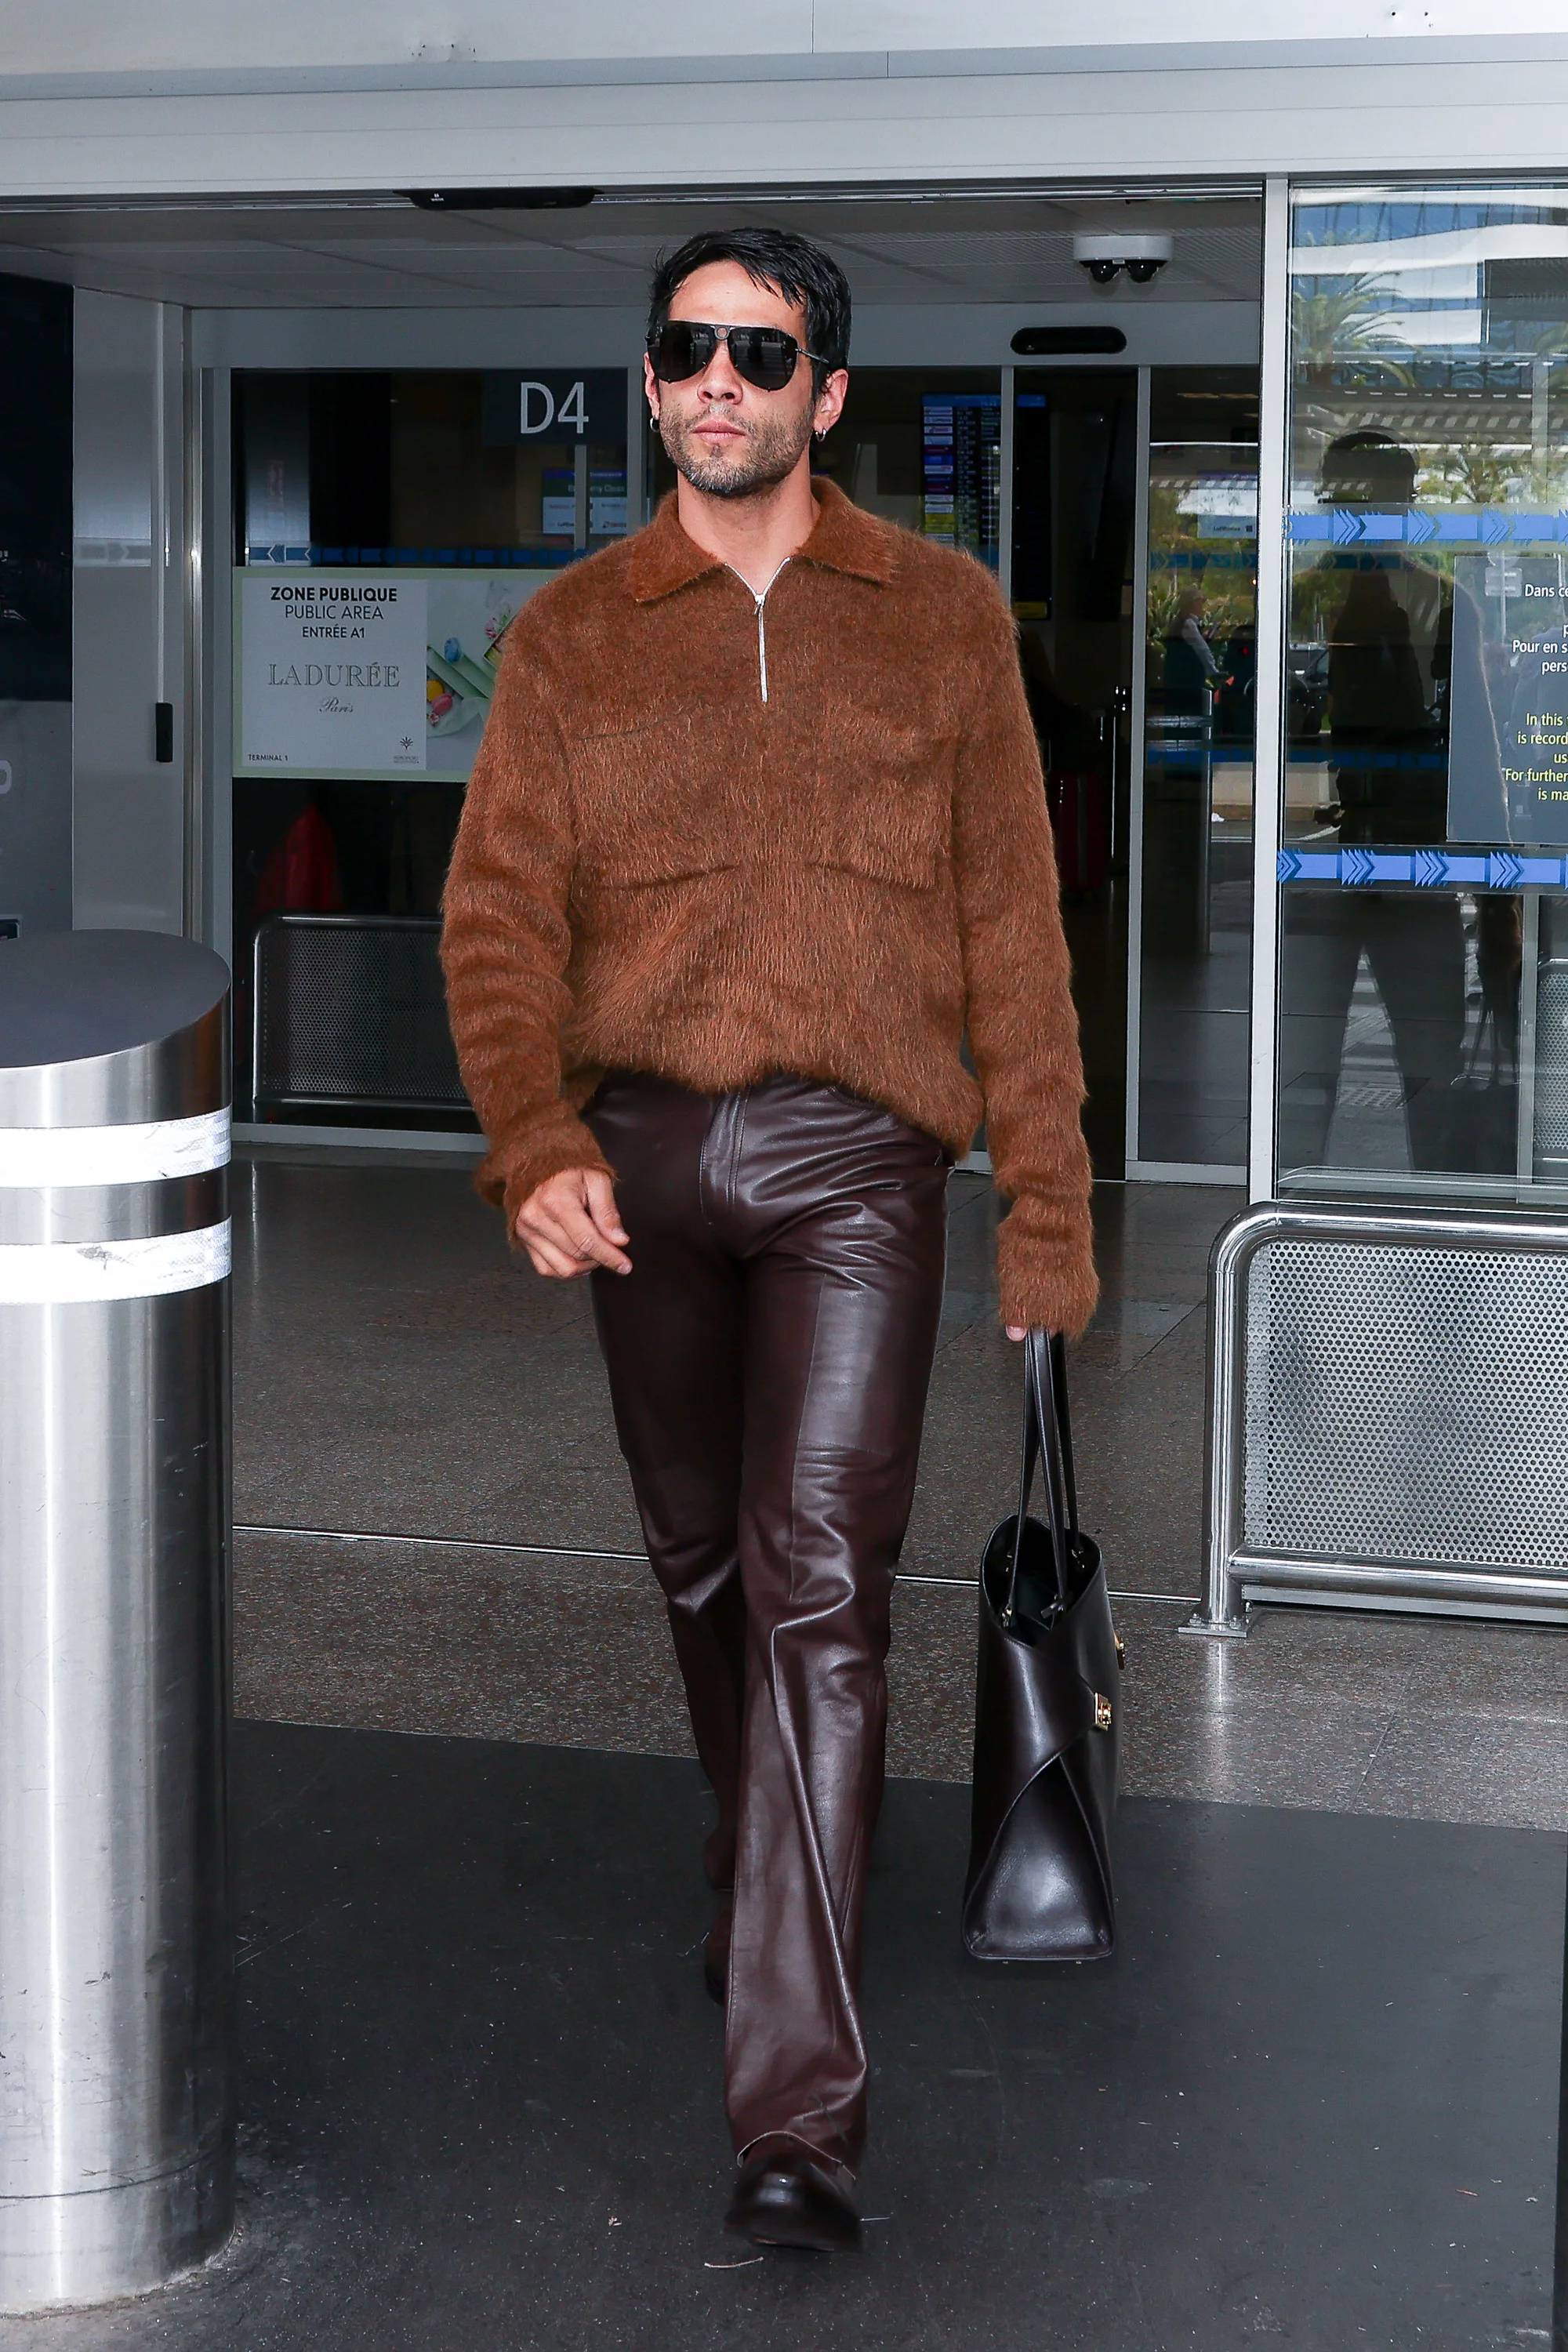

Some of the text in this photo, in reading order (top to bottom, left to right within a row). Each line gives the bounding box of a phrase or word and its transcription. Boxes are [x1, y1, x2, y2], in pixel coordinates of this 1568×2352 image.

[521, 382, 589, 434] D4
[270, 586, 397, 602] ZONE PUBLIQUE
[1525, 584, 1555, 597] Dans
[285, 604, 383, 619] PUBLIC AREA
[303, 624, 365, 638] ENTRÉE A1
[1512, 639, 1568, 653] Pour en s
[268, 662, 400, 688] LADURÉE
[1542, 662, 1568, 675] pers
[319, 696, 354, 713] Paris
[1526, 713, 1537, 725] In
[1541, 713, 1563, 726] this
[1517, 731, 1568, 745] is record
[1554, 753, 1568, 764] us
[1505, 768, 1568, 782] For further
[1537, 787, 1547, 800] is
